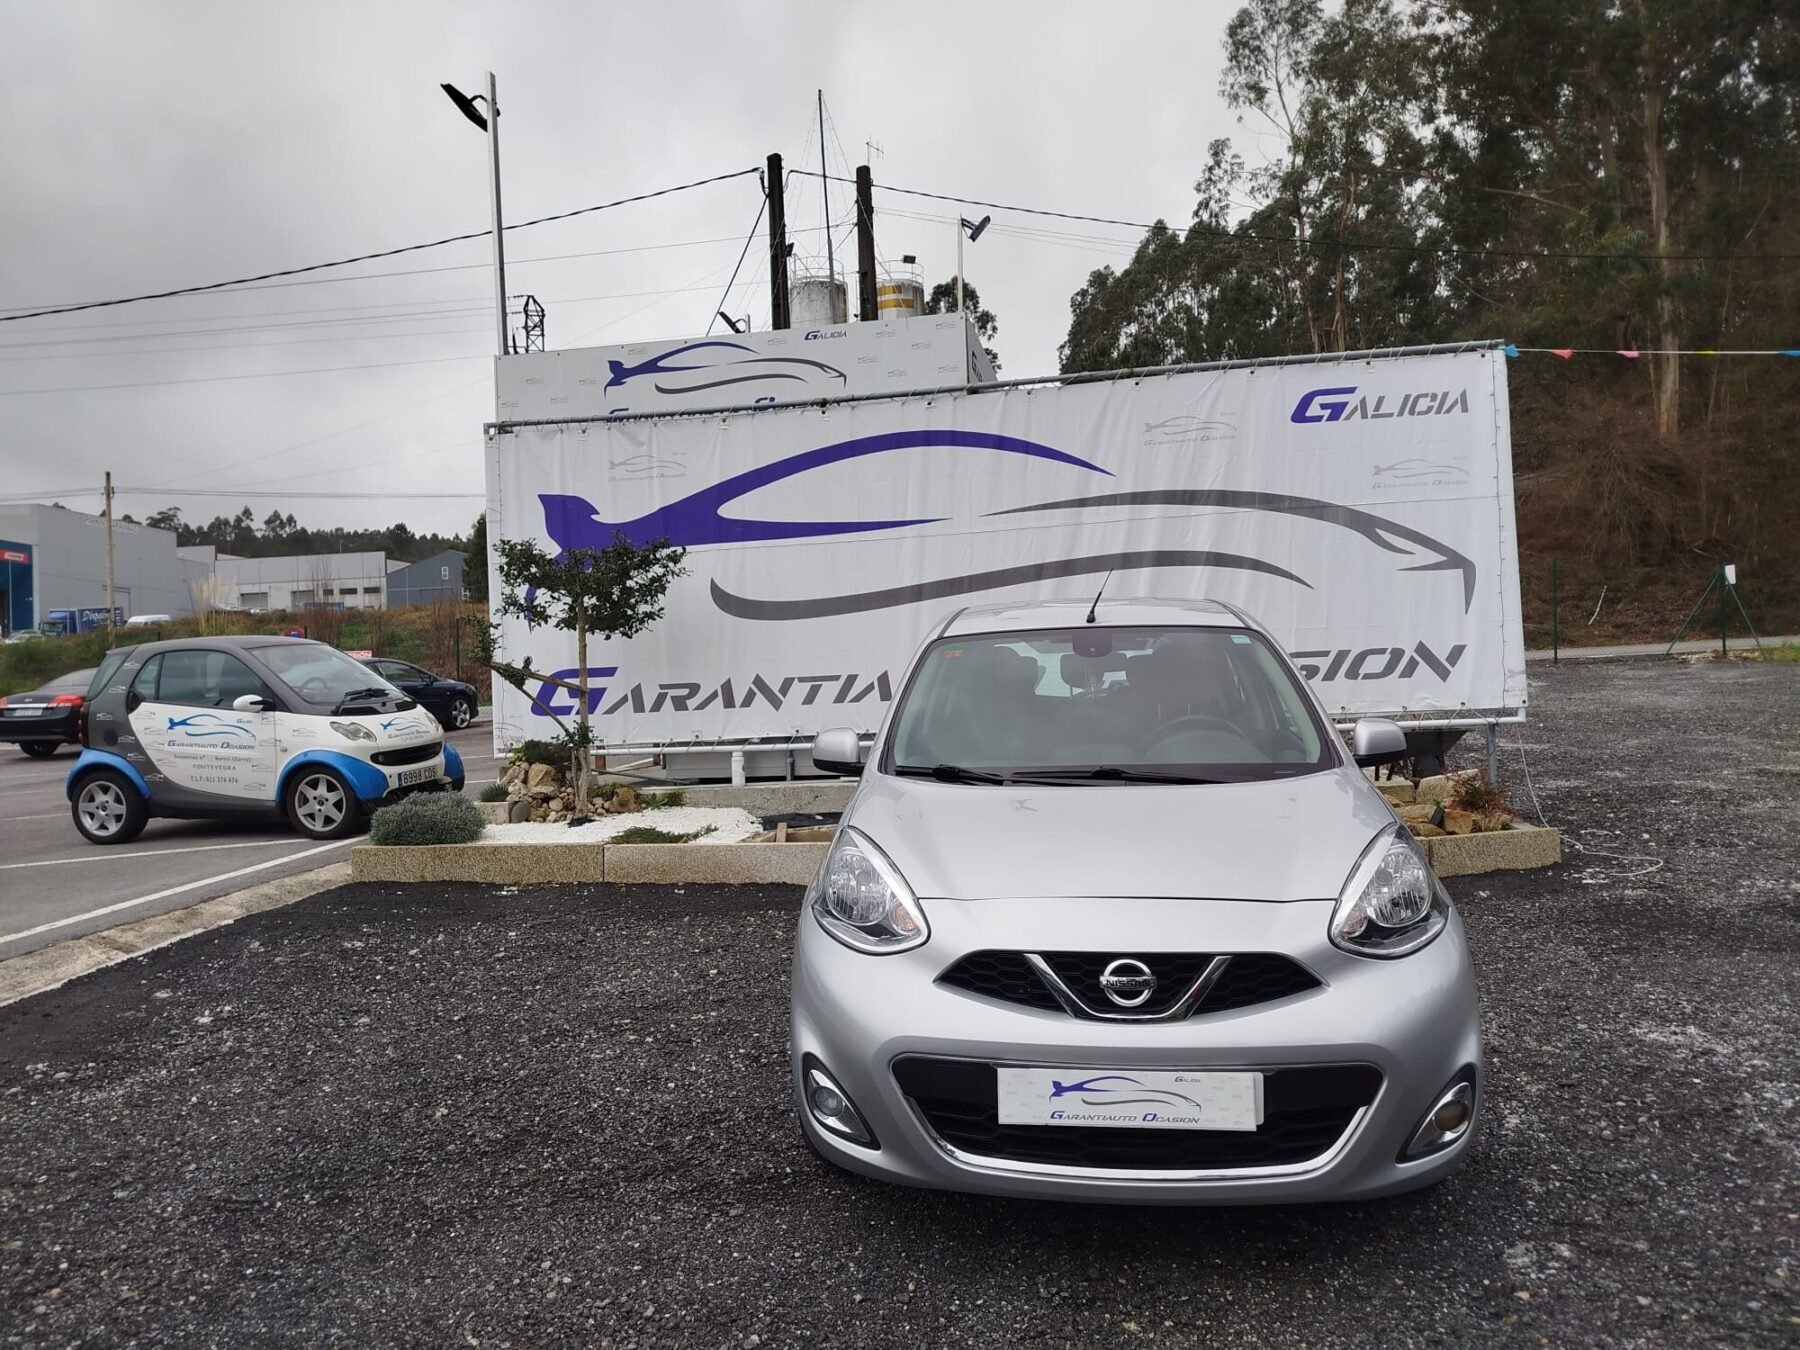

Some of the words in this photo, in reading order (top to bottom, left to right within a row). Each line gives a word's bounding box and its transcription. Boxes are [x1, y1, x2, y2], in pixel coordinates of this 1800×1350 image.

[804, 330, 847, 340] GALICIA
[1290, 386, 1469, 424] GALICIA
[531, 666, 893, 716] GARANTIA
[1290, 640, 1467, 683] SION
[403, 770, 422, 784] 8998
[1106, 979, 1151, 987] NISSAN
[1050, 1110, 1137, 1122] GARANTIAUTO
[1142, 1113, 1200, 1124] OCASION
